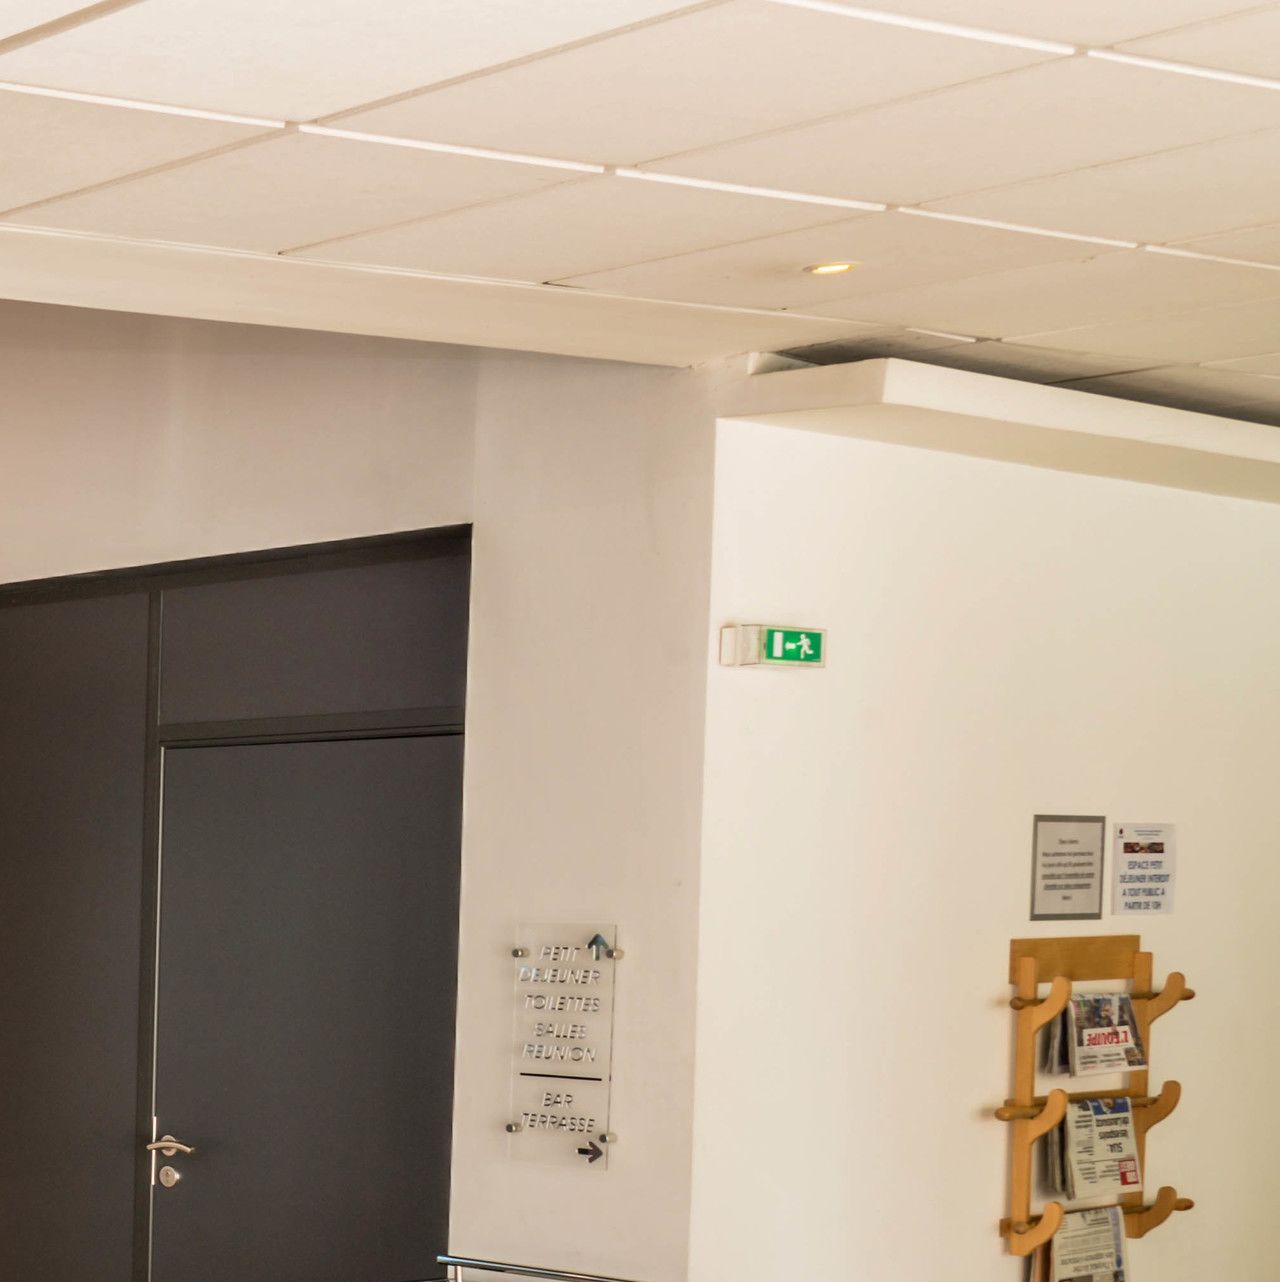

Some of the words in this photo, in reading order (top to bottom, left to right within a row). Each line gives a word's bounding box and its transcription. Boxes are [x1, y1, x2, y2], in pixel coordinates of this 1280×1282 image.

[1127, 860, 1149, 870] ESPACE
[540, 945, 581, 961] PETIT
[519, 967, 601, 985] DEJEUNER
[525, 994, 601, 1012] TOILETTES
[534, 1022, 587, 1039] SALLES
[522, 1043, 596, 1062] REUNION
[542, 1092, 573, 1107] BAR
[521, 1112, 595, 1133] TERRASSE
